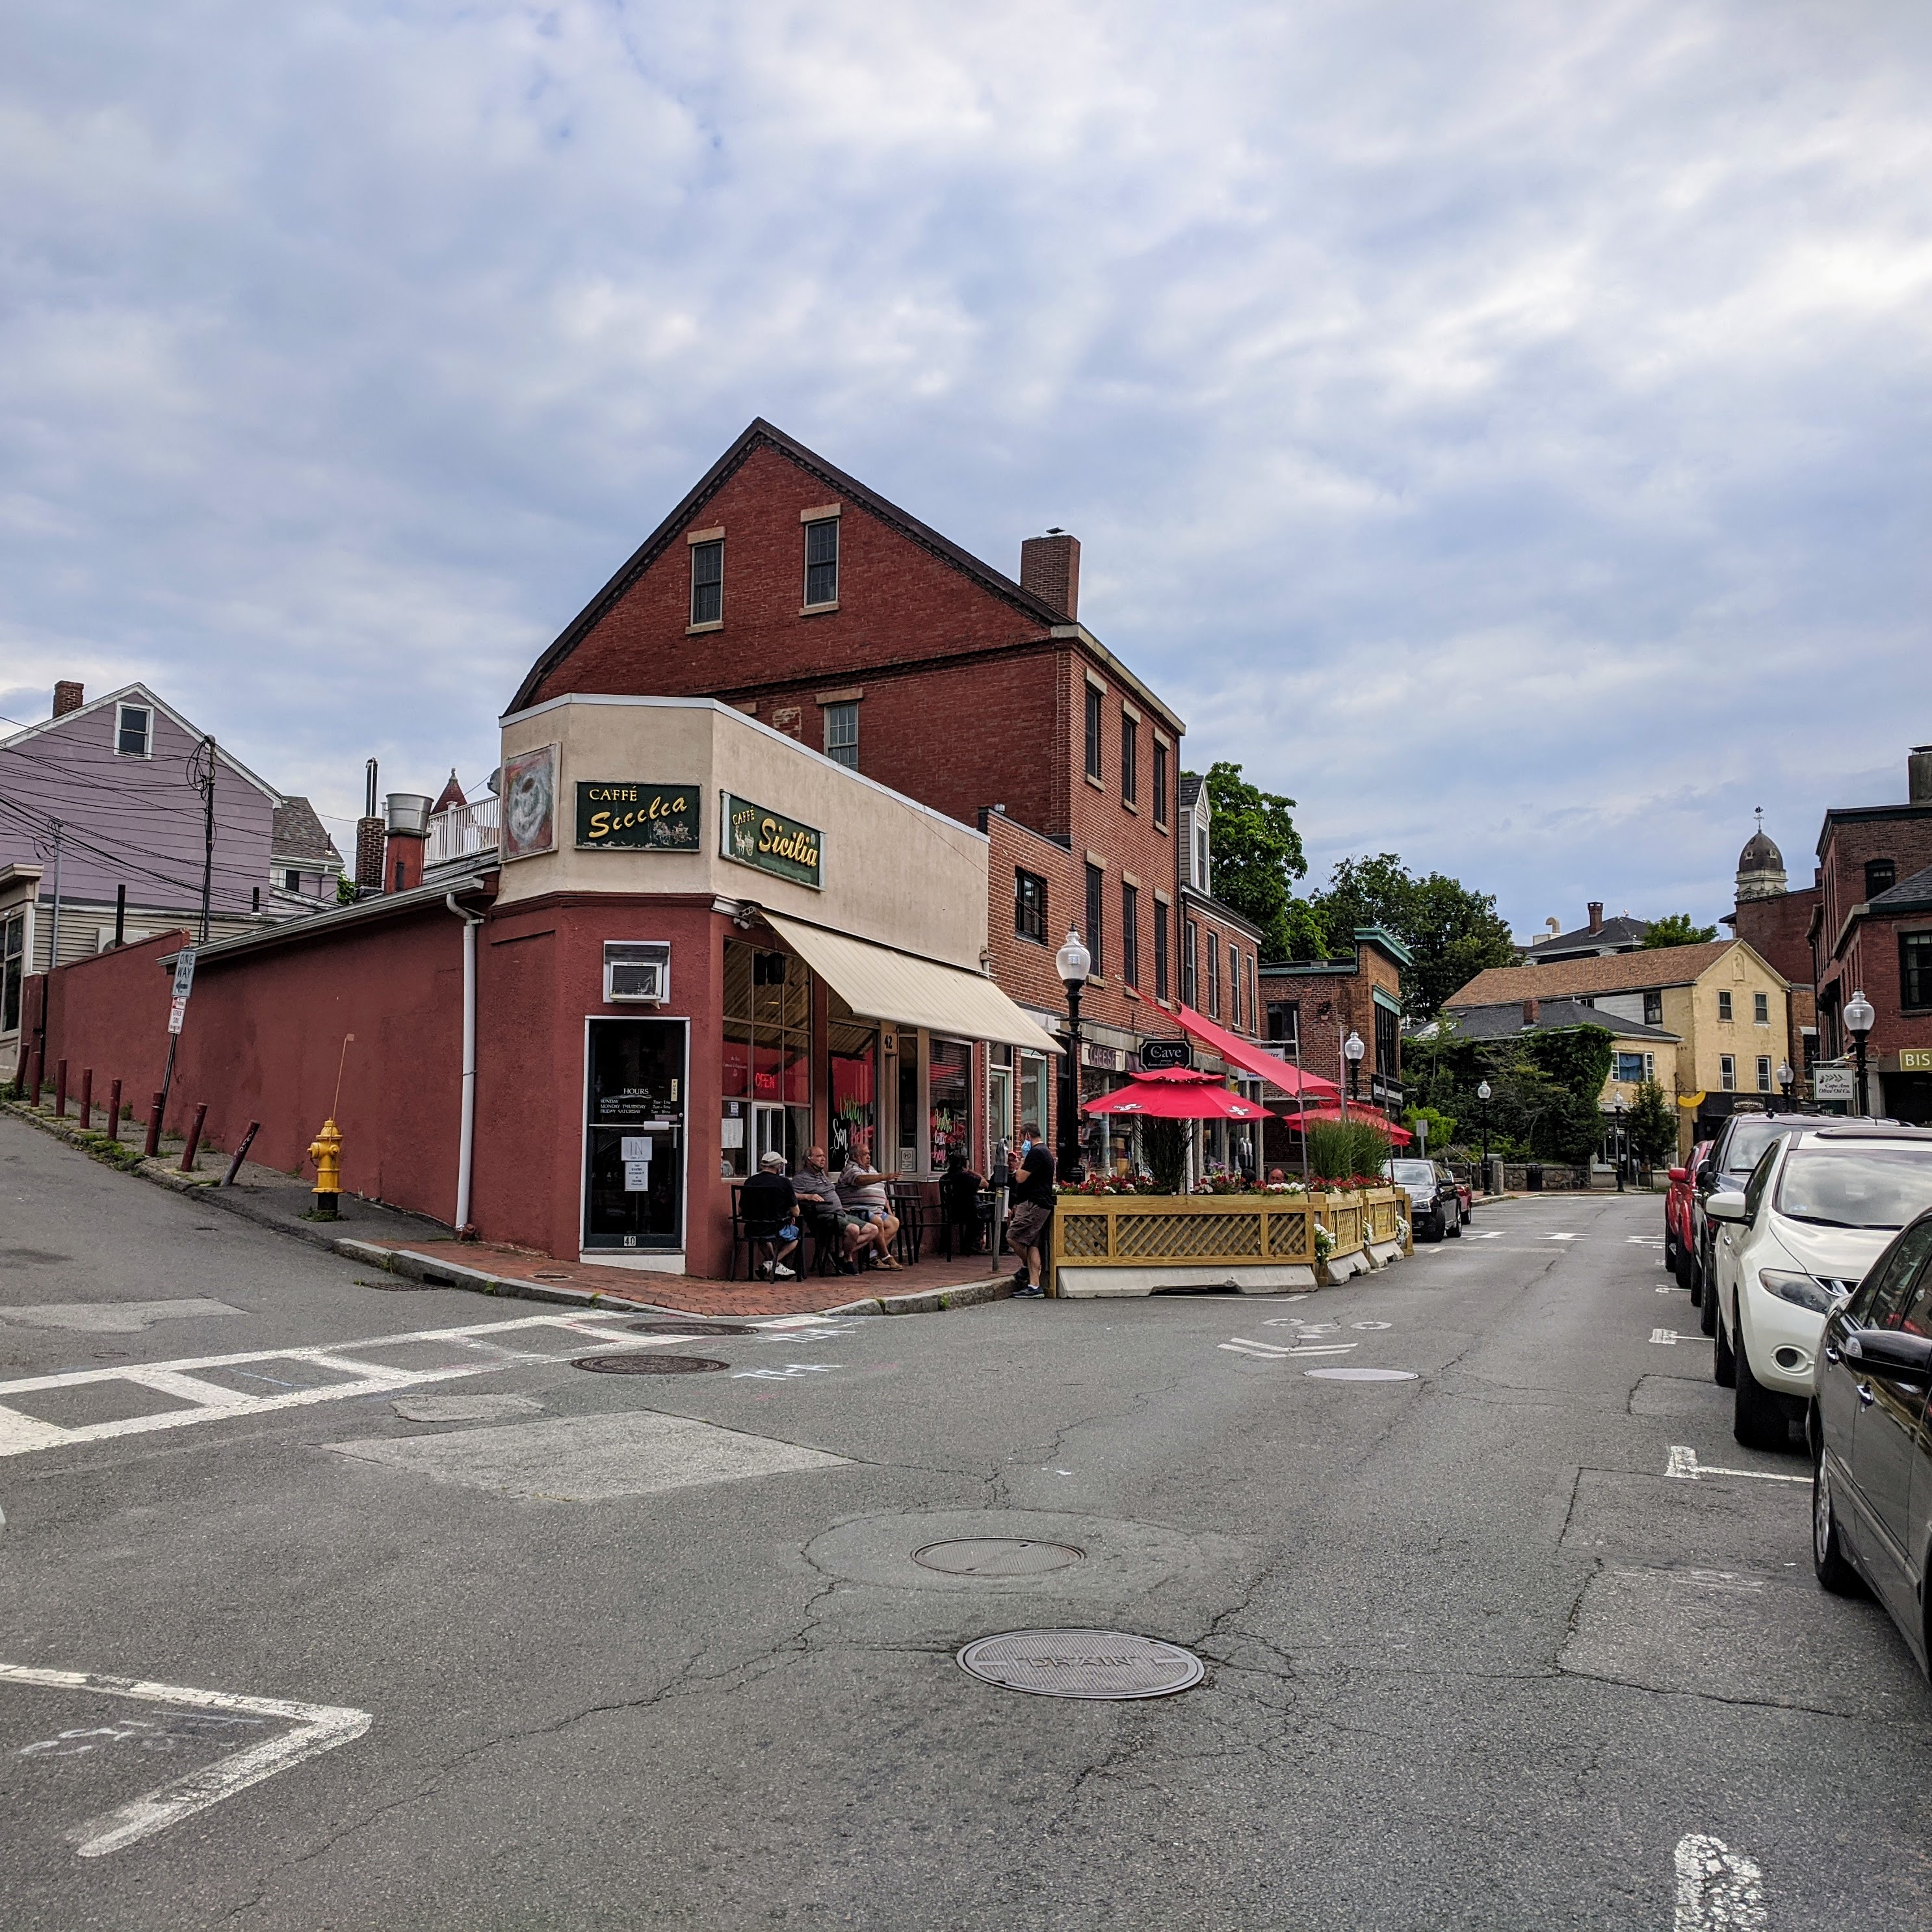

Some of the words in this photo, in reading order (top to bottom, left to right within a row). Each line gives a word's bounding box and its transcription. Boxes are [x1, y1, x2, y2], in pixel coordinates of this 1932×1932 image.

[589, 785, 637, 802] CAFFÉ
[588, 796, 688, 839] Sicilia
[732, 805, 755, 825] CAFFÉ
[759, 818, 818, 867] Sicilia
[179, 954, 194, 965] ONE
[177, 967, 192, 978] WAY
[885, 1034, 893, 1049] 42
[1090, 1046, 1116, 1069] CHEESE
[1150, 1045, 1182, 1058] Cave
[755, 1073, 776, 1089] OPEN
[833, 1118, 848, 1151] San
[630, 1139, 643, 1156] IN
[625, 1236, 635, 1246] 40
[1026, 1656, 1134, 1667] DRAIN
